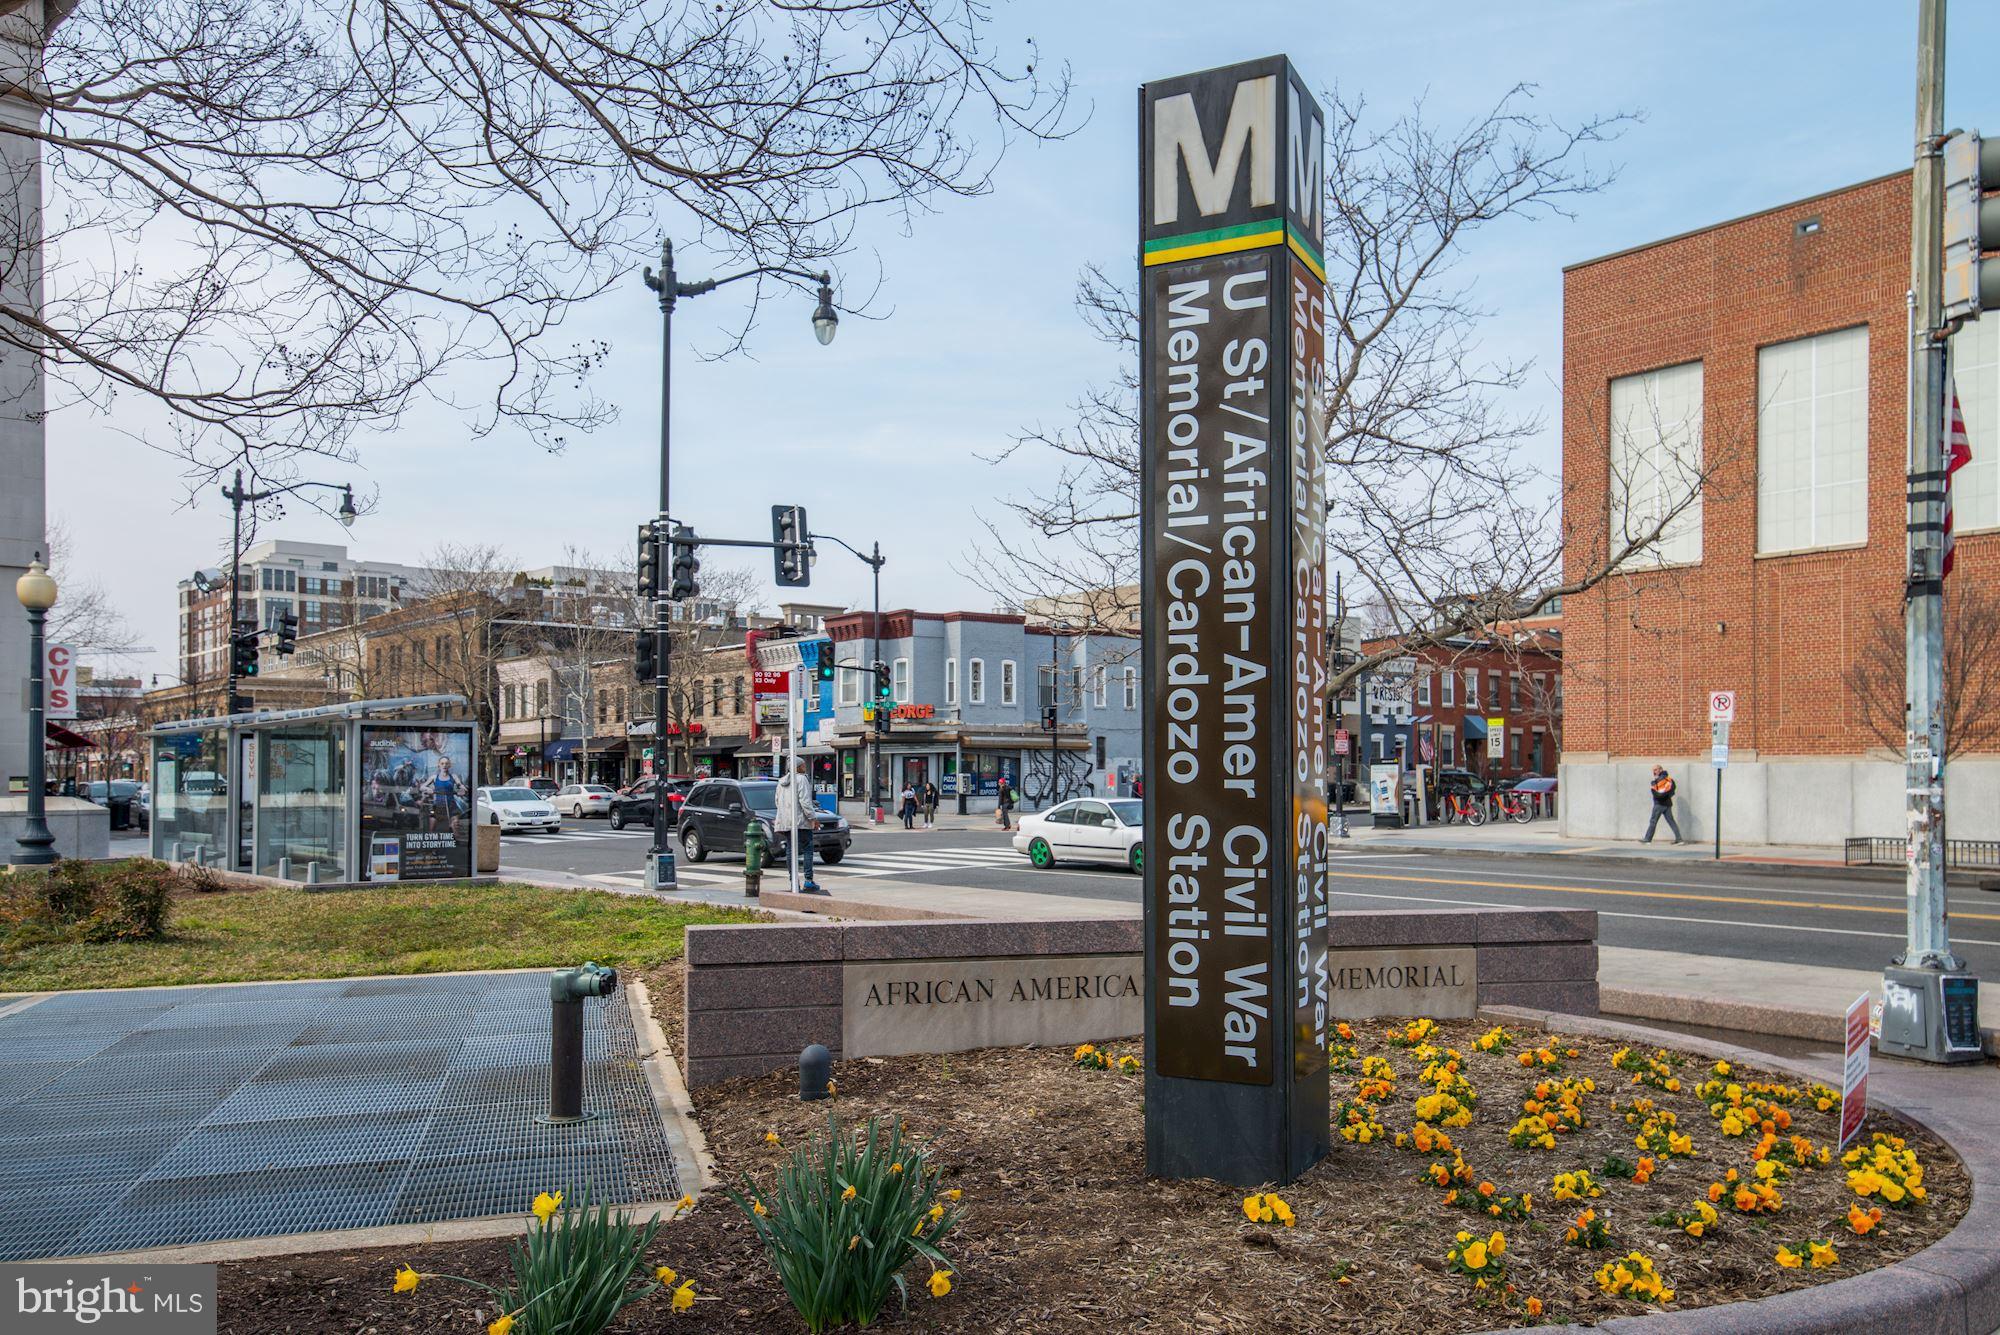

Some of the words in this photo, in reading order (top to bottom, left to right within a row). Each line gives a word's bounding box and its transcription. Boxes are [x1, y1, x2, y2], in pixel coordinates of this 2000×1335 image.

[1154, 75, 1276, 225] M
[1289, 79, 1322, 243] M
[1222, 271, 1267, 311] U
[1310, 295, 1323, 336] U
[48, 647, 69, 708] CVS
[889, 703, 936, 719] EORGE
[1490, 737, 1501, 747] 15
[406, 833, 423, 841] TURN
[440, 832, 454, 840] TIME
[406, 841, 421, 849] INTO
[422, 840, 457, 848] STORYTIME
[1313, 821, 1327, 929] Civil
[1166, 813, 1210, 1007] Station
[1222, 825, 1267, 937] Civil
[1297, 812, 1312, 1008] Station
[864, 978, 995, 1006] AFRICAN
[1010, 973, 1144, 1001] AMERICA
[1328, 965, 1465, 990] MEMORIAL
[1223, 962, 1267, 1067] War
[1314, 950, 1328, 1051] War
